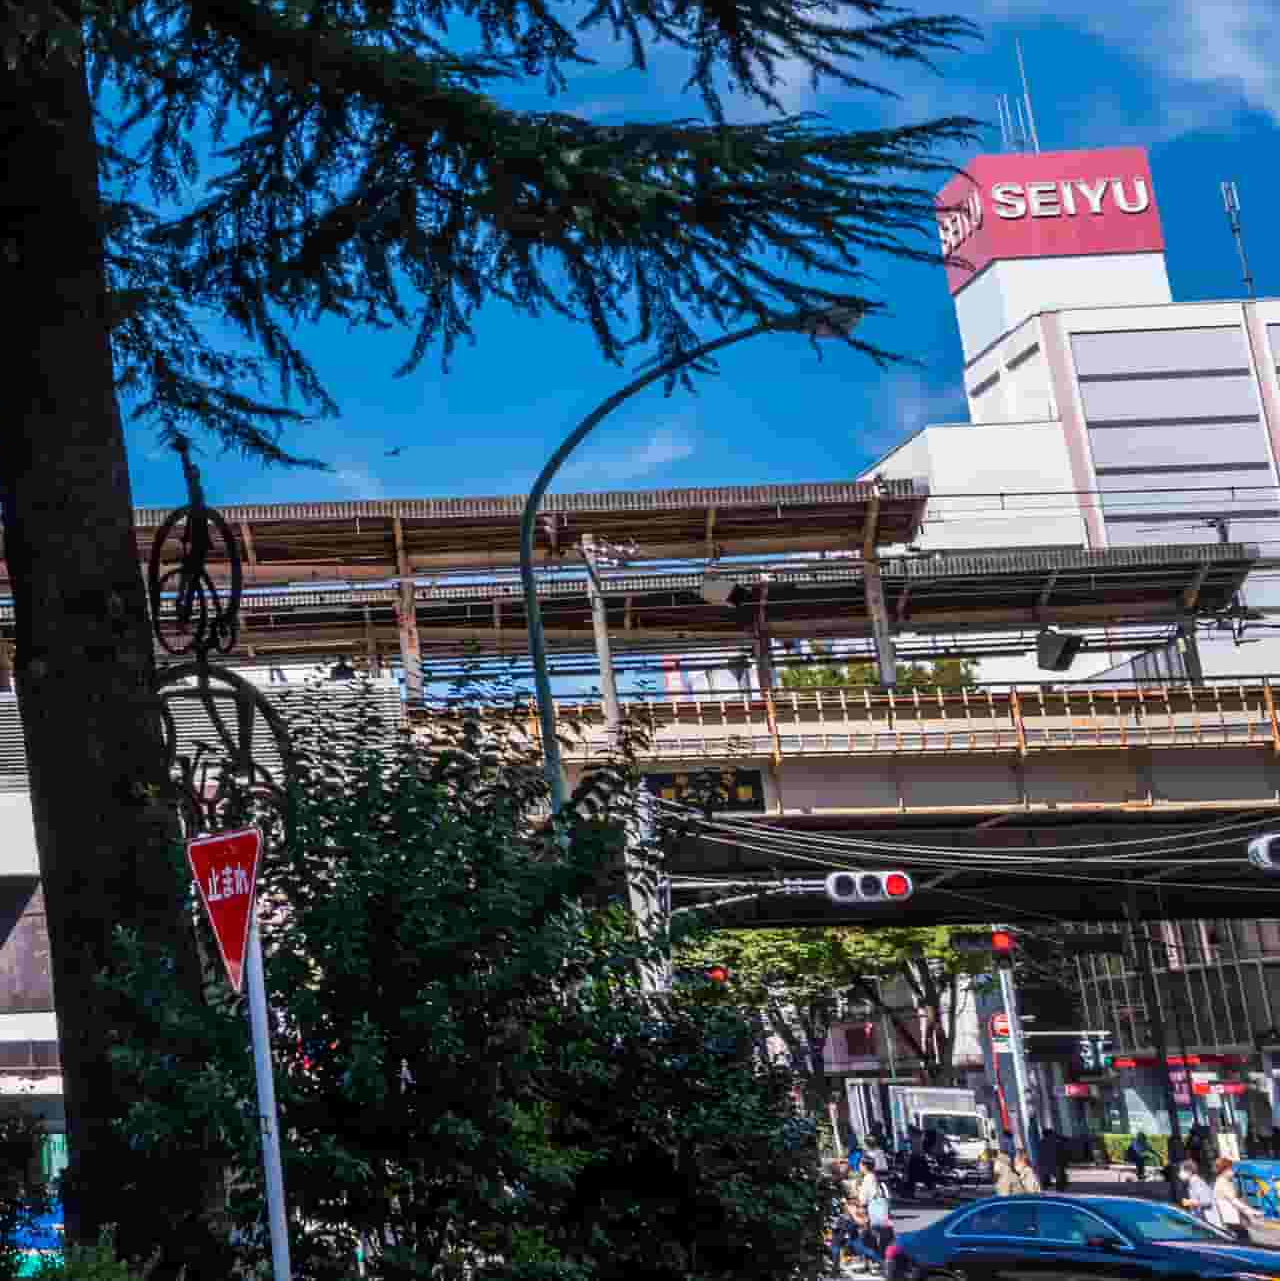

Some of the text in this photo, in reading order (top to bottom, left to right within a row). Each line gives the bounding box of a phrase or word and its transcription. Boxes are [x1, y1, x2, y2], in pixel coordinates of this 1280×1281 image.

[991, 175, 1151, 220] SEIYU
[207, 866, 251, 901] 止まれ
